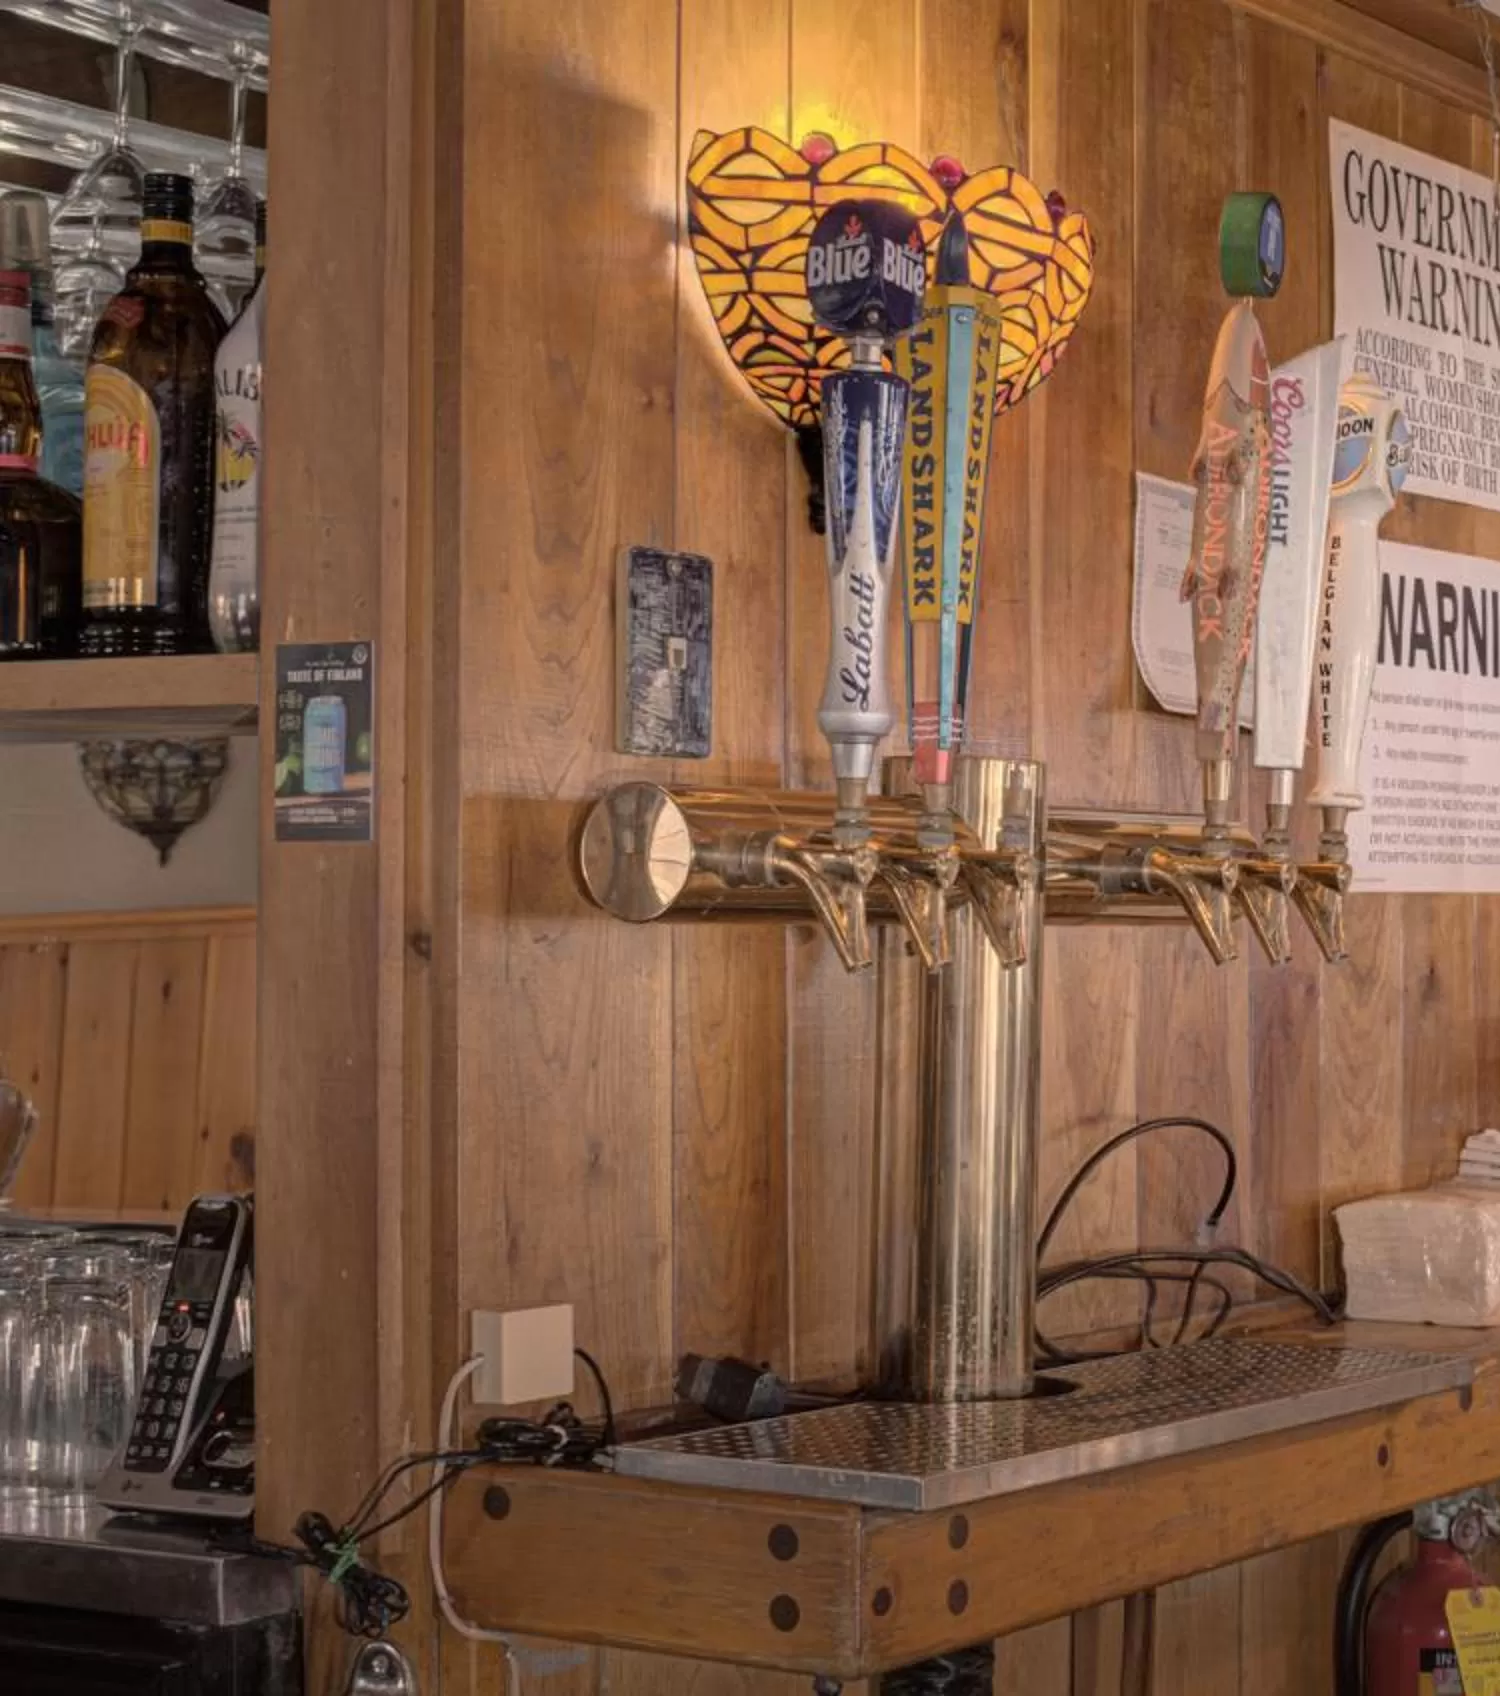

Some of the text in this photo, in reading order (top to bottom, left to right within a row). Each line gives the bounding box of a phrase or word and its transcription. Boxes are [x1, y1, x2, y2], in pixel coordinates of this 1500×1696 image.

[808, 243, 871, 288] Blue
[883, 237, 925, 297] Blue
[1355, 327, 1431, 371] ACCORDING
[1438, 351, 1457, 378] TO
[1463, 357, 1484, 387] THE
[1271, 375, 1305, 466] Coors
[1403, 397, 1476, 436] ALCOHOLIC
[1424, 374, 1474, 408] WOMEN
[909, 327, 935, 607] LANDSHARK
[957, 332, 992, 607] LANDSHARK
[1409, 425, 1487, 465] PREGNANCY
[1441, 458, 1460, 484] OF
[1464, 463, 1497, 496] BIRTH
[839, 571, 875, 713] Labatt
[1319, 536, 1341, 748] BELGIAN WHITE
